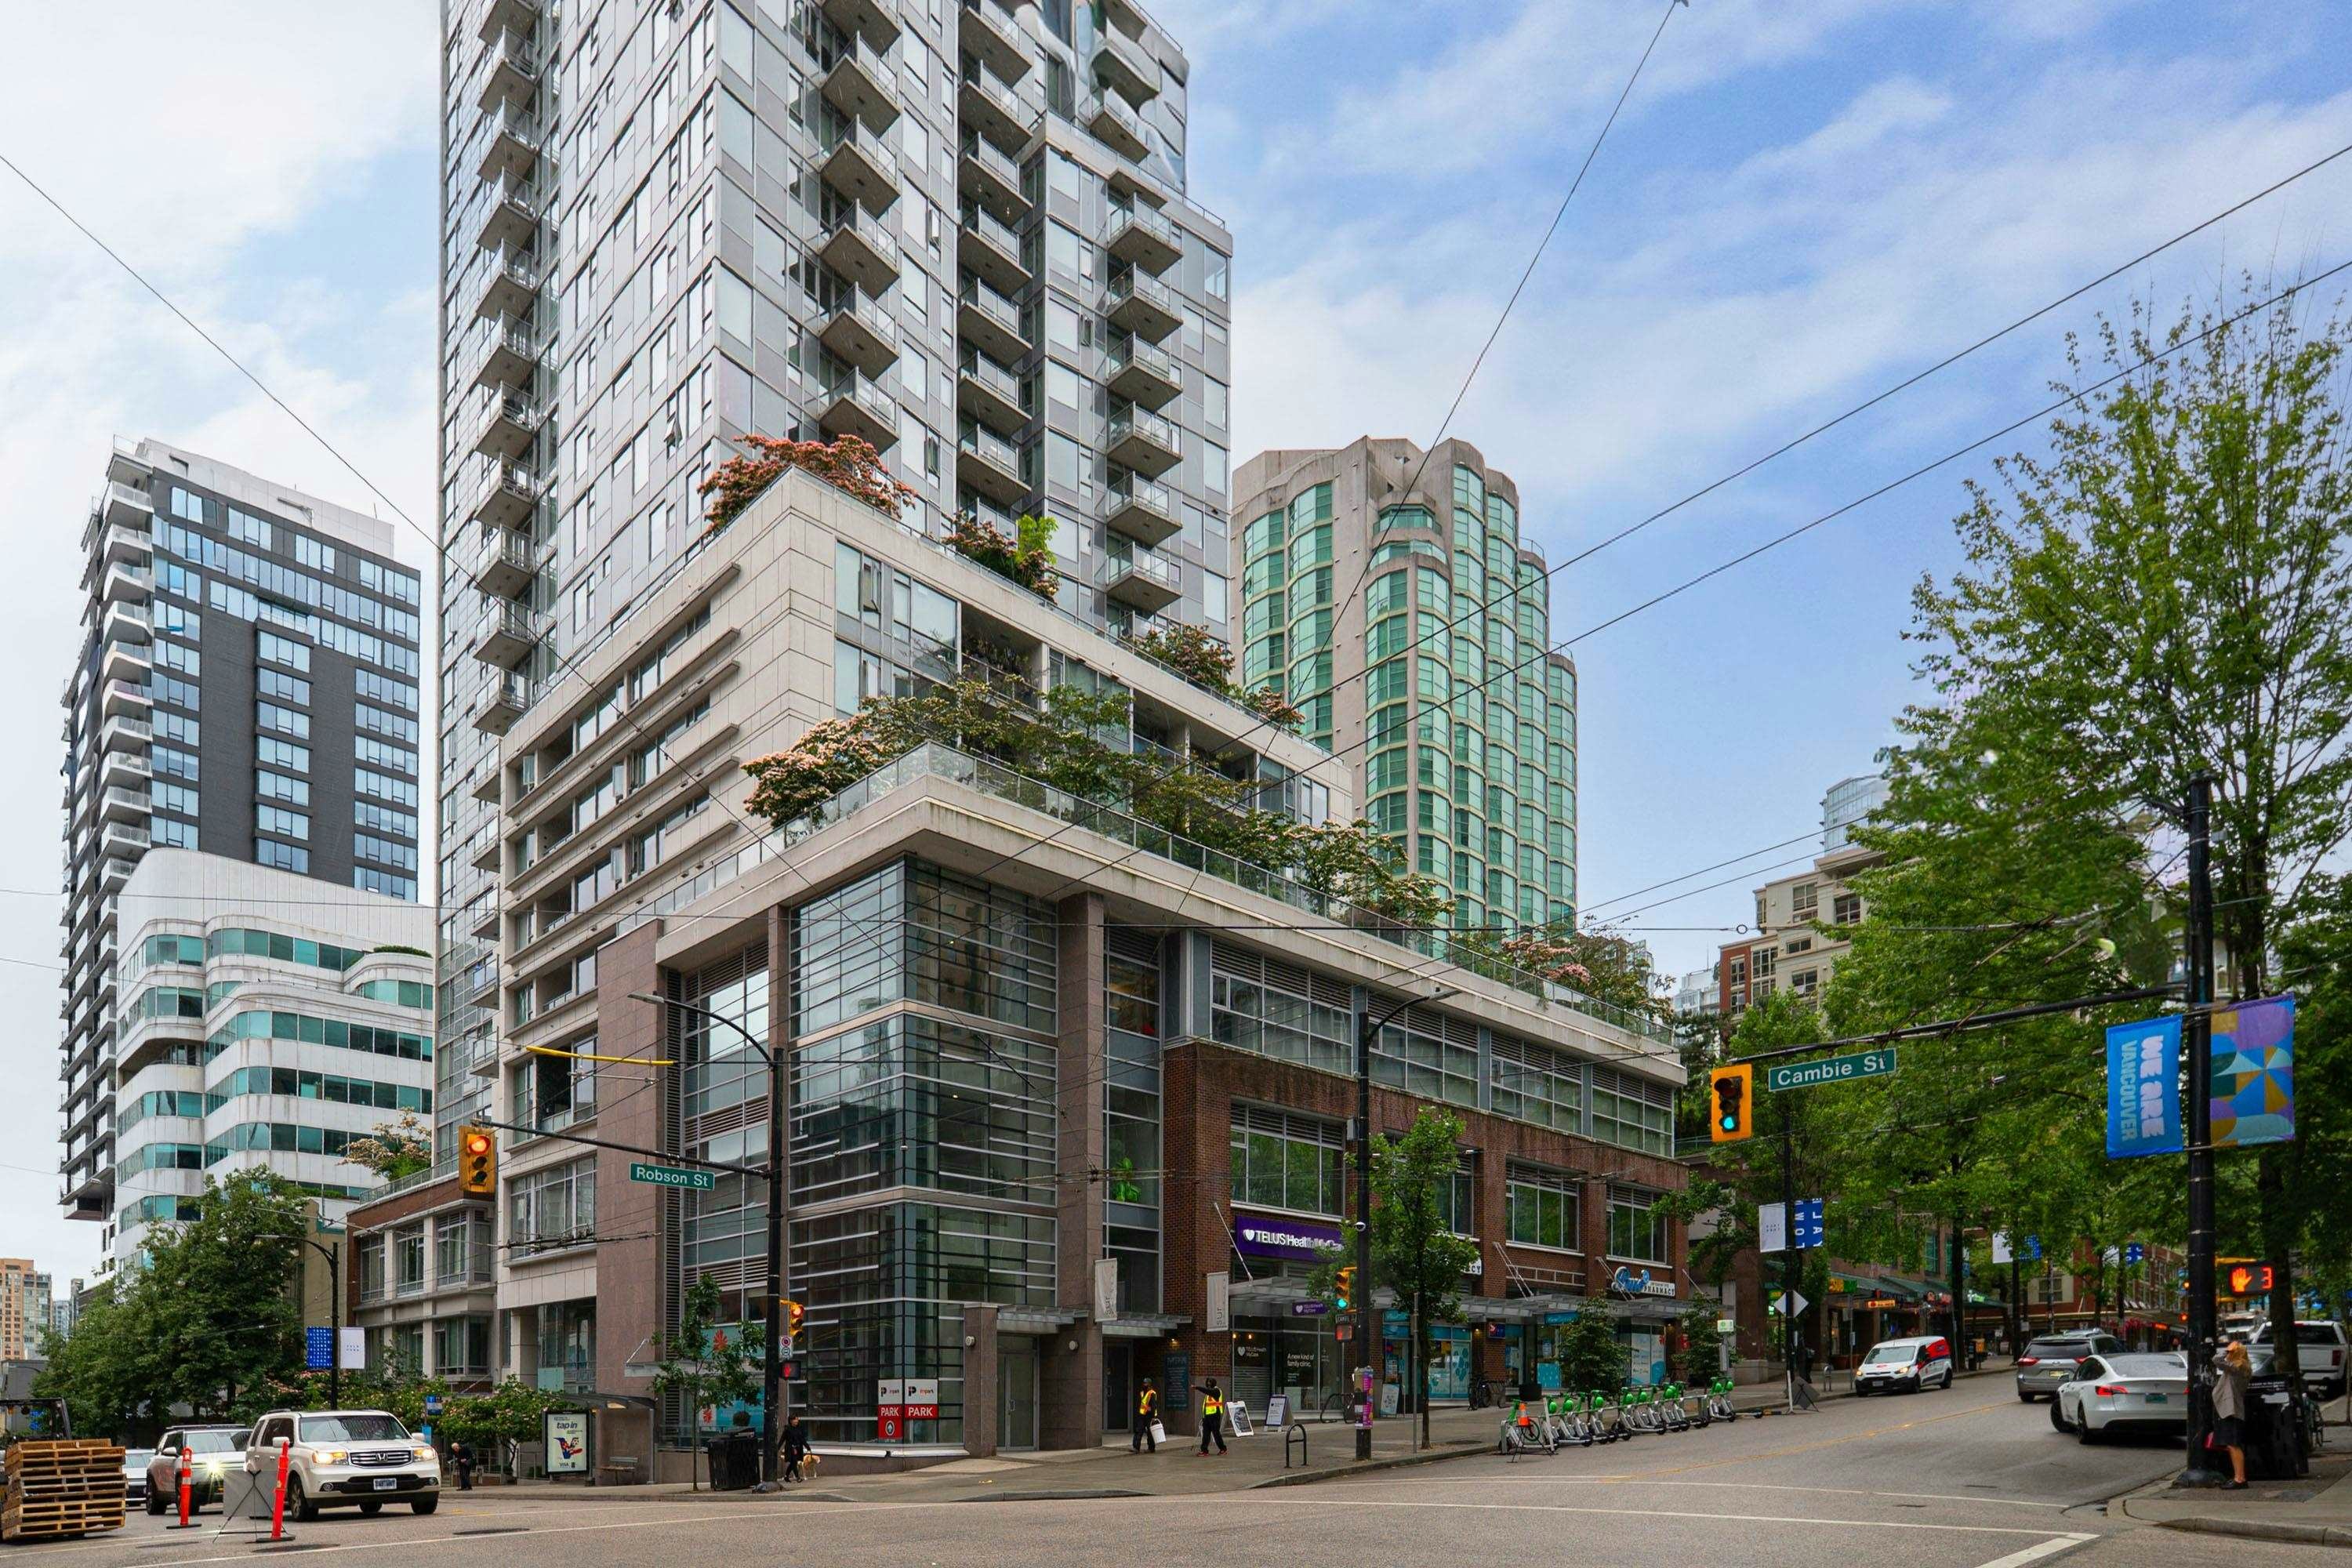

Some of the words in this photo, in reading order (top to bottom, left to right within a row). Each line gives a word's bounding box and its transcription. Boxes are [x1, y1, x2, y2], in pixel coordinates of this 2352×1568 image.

[2140, 1034, 2164, 1079] WE
[1777, 1062, 1853, 1086] Cambie
[1864, 1055, 1886, 1073] St
[2120, 1040, 2138, 1142] VANCOUVER
[636, 1166, 688, 1185] Robson
[694, 1174, 708, 1187] St
[1254, 1230, 1286, 1245] TELUS
[1287, 1234, 1313, 1248] Health
[2262, 1266, 2272, 1289] 3
[1643, 1284, 1675, 1295] PHARMACY
[880, 1407, 899, 1416] PARK
[908, 1407, 933, 1416] PARK
